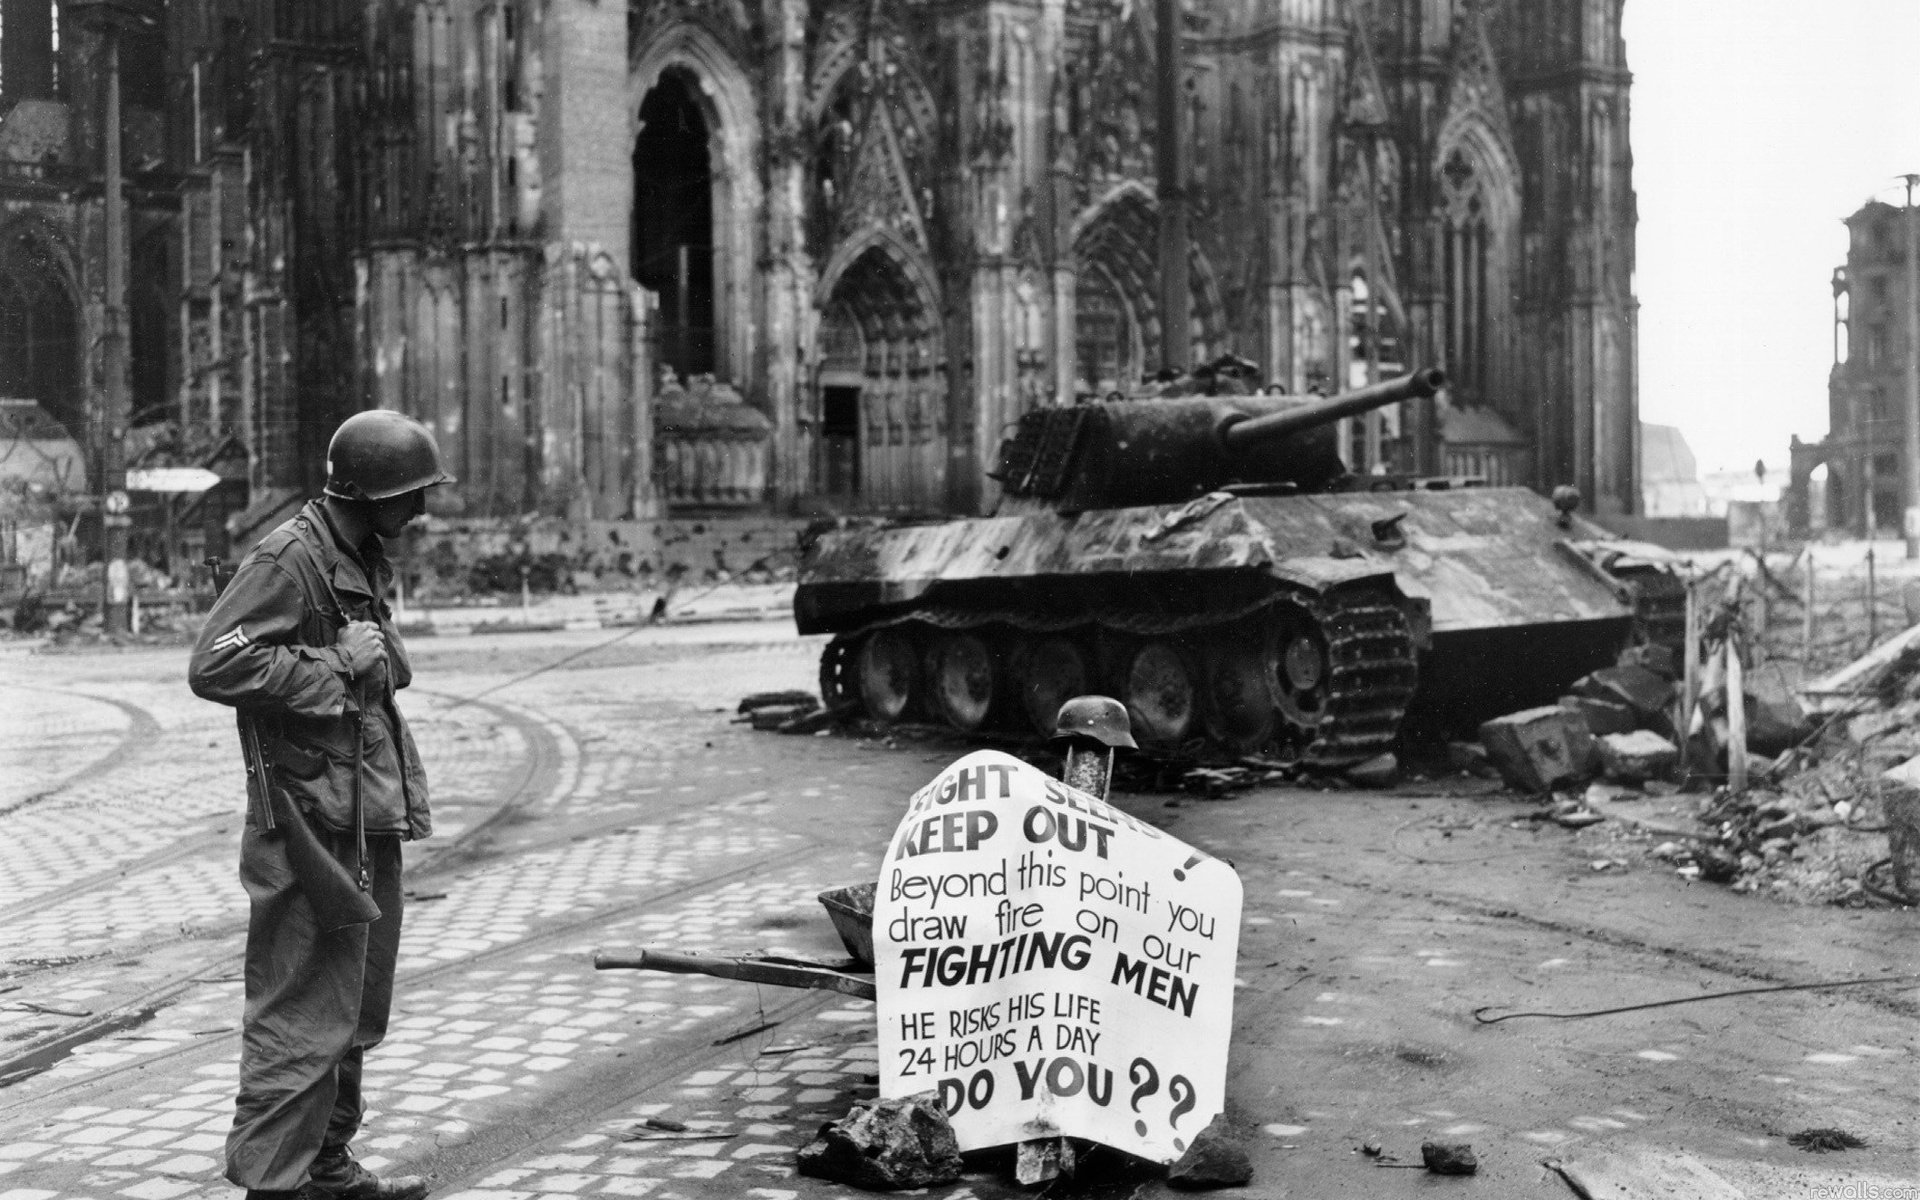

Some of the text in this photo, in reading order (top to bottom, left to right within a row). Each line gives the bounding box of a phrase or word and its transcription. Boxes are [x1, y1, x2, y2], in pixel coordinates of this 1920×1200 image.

[909, 764, 1018, 821] SIGHT
[895, 810, 998, 861] KEEP
[1023, 805, 1115, 860] OUT
[891, 849, 1215, 940] Beyond this point you
[889, 899, 1201, 973] draw fire on our
[900, 931, 1200, 1018] FIGHTING MEN
[901, 992, 1100, 1041] HE RISKS HIS LIFE
[899, 1024, 1101, 1077] 24 HOURS A DAY
[938, 1069, 995, 1118] DO
